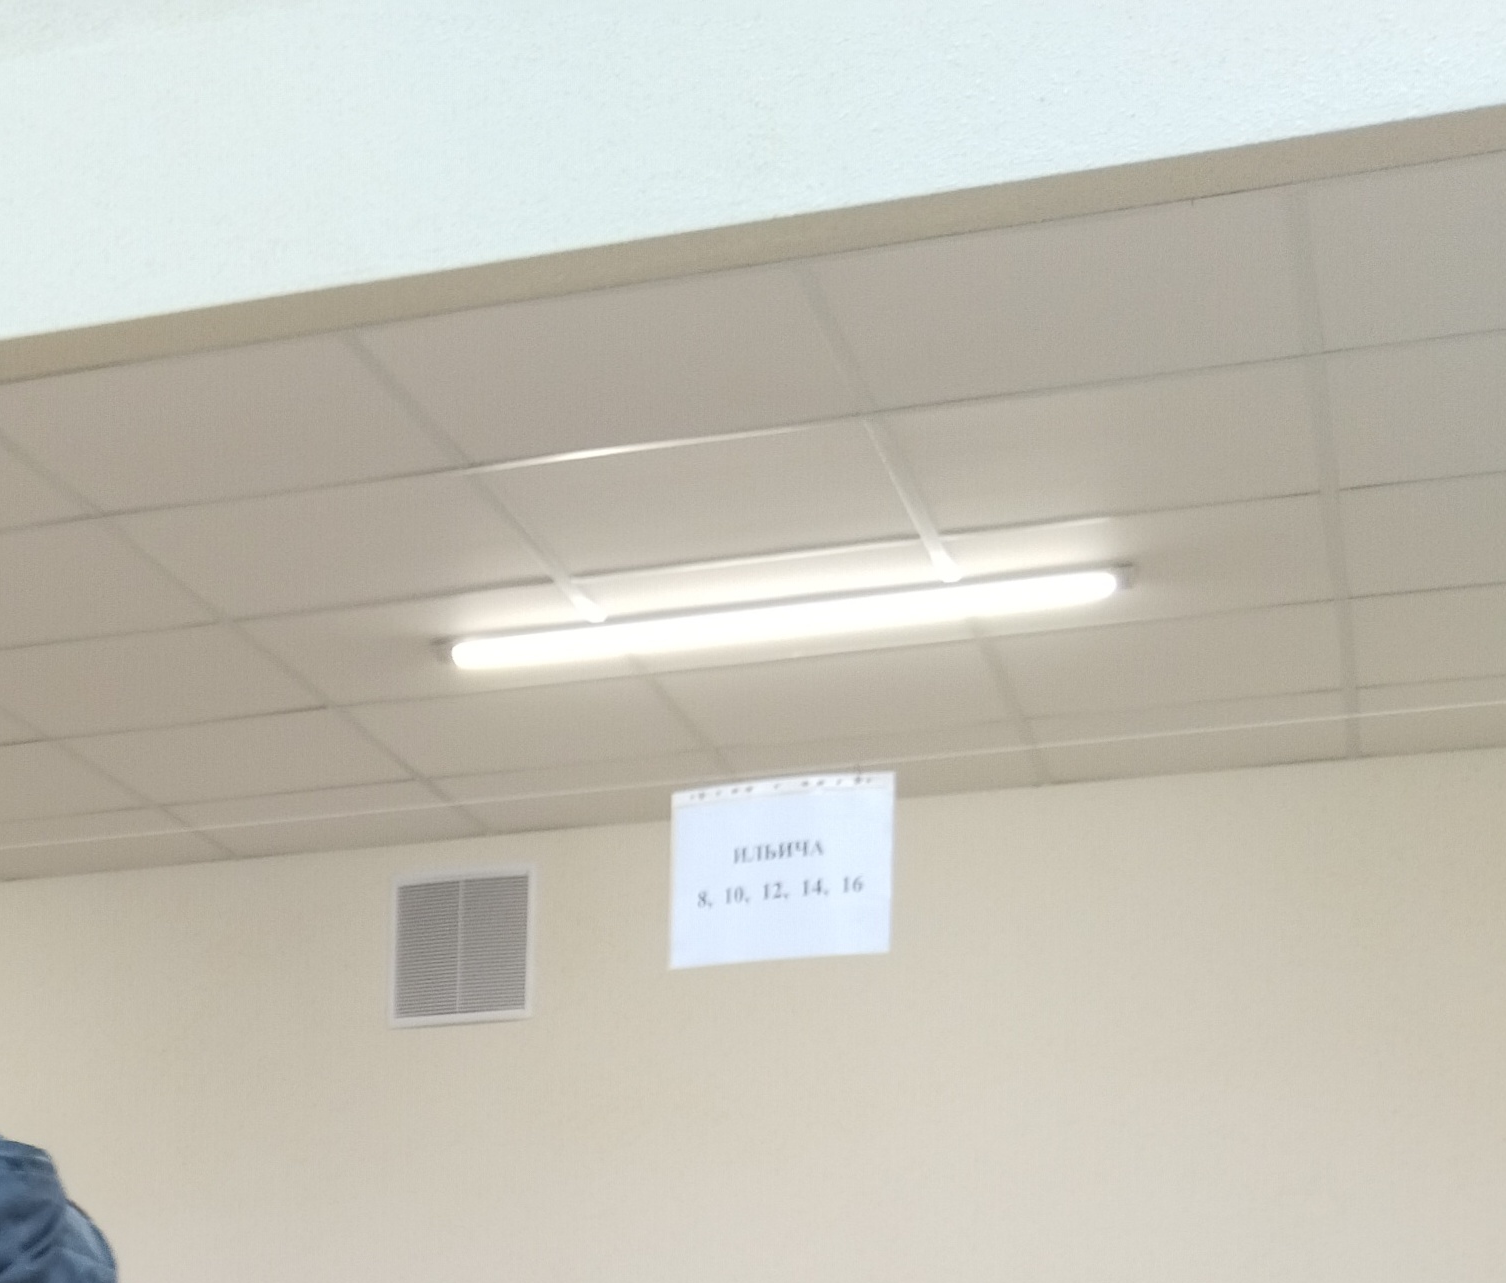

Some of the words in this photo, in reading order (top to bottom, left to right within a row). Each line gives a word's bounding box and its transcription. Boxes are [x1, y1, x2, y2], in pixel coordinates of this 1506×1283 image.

[733, 840, 824, 864] ИЛЬИЧА
[697, 890, 713, 909] 8,
[725, 885, 750, 905] 10,
[763, 881, 791, 901] 12,
[802, 878, 829, 897] 14,
[842, 874, 865, 894] 16
